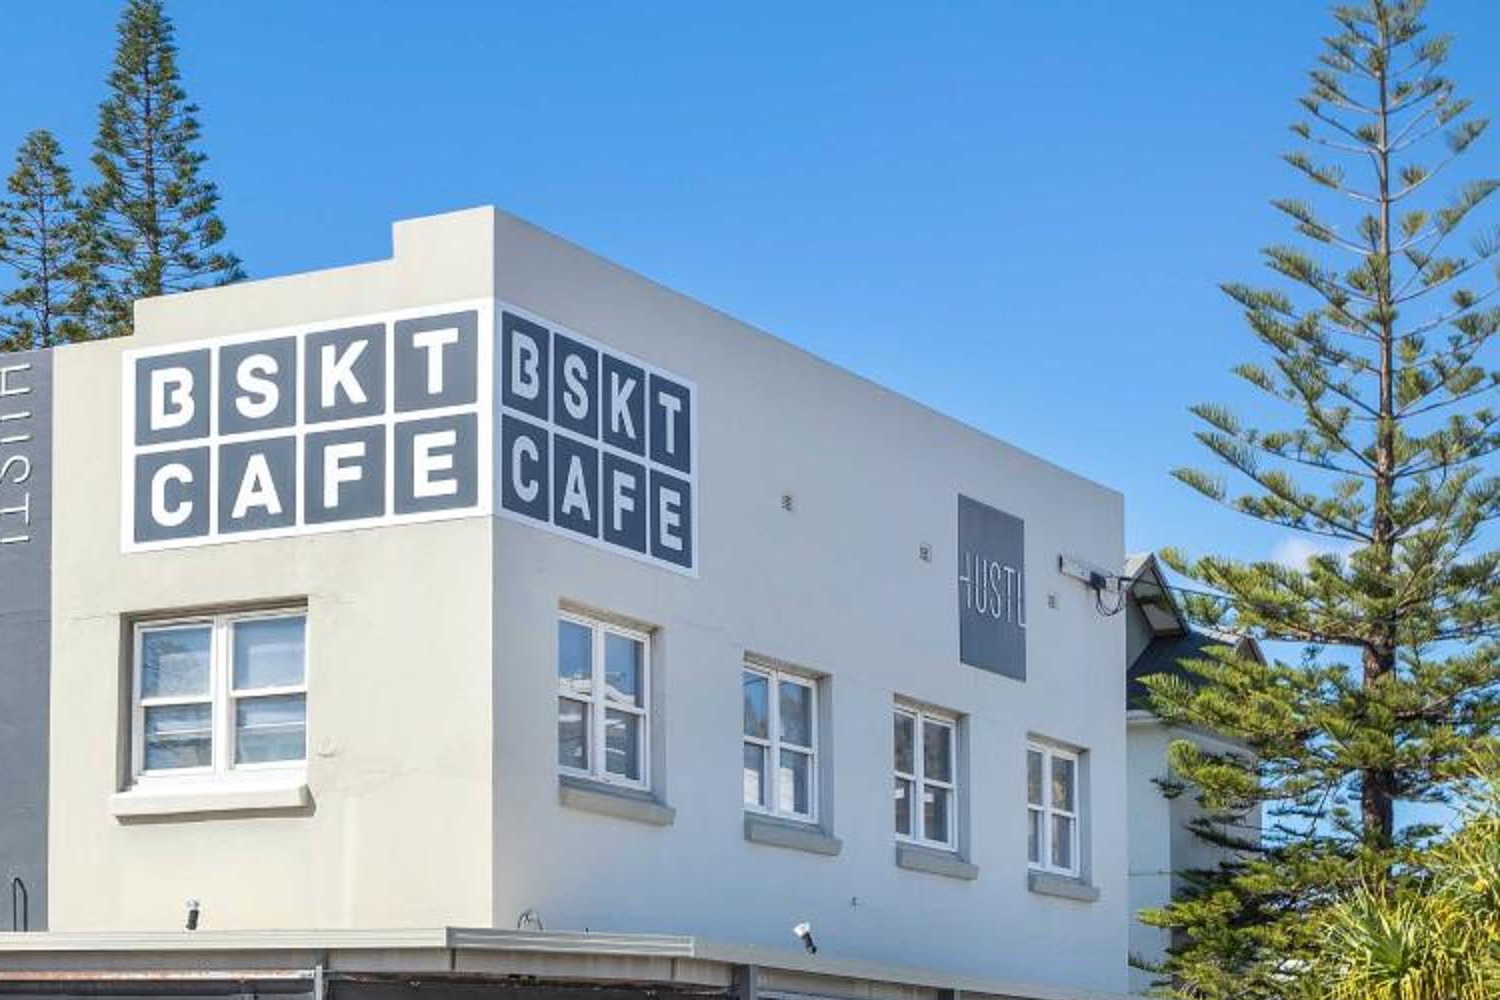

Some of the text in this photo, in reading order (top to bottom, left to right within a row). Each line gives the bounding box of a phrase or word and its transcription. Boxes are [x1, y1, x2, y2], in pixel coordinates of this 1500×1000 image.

[151, 327, 459, 431] BSKT
[511, 330, 682, 454] BSKT
[151, 429, 459, 528] CAFE
[511, 435, 683, 551] CAFE
